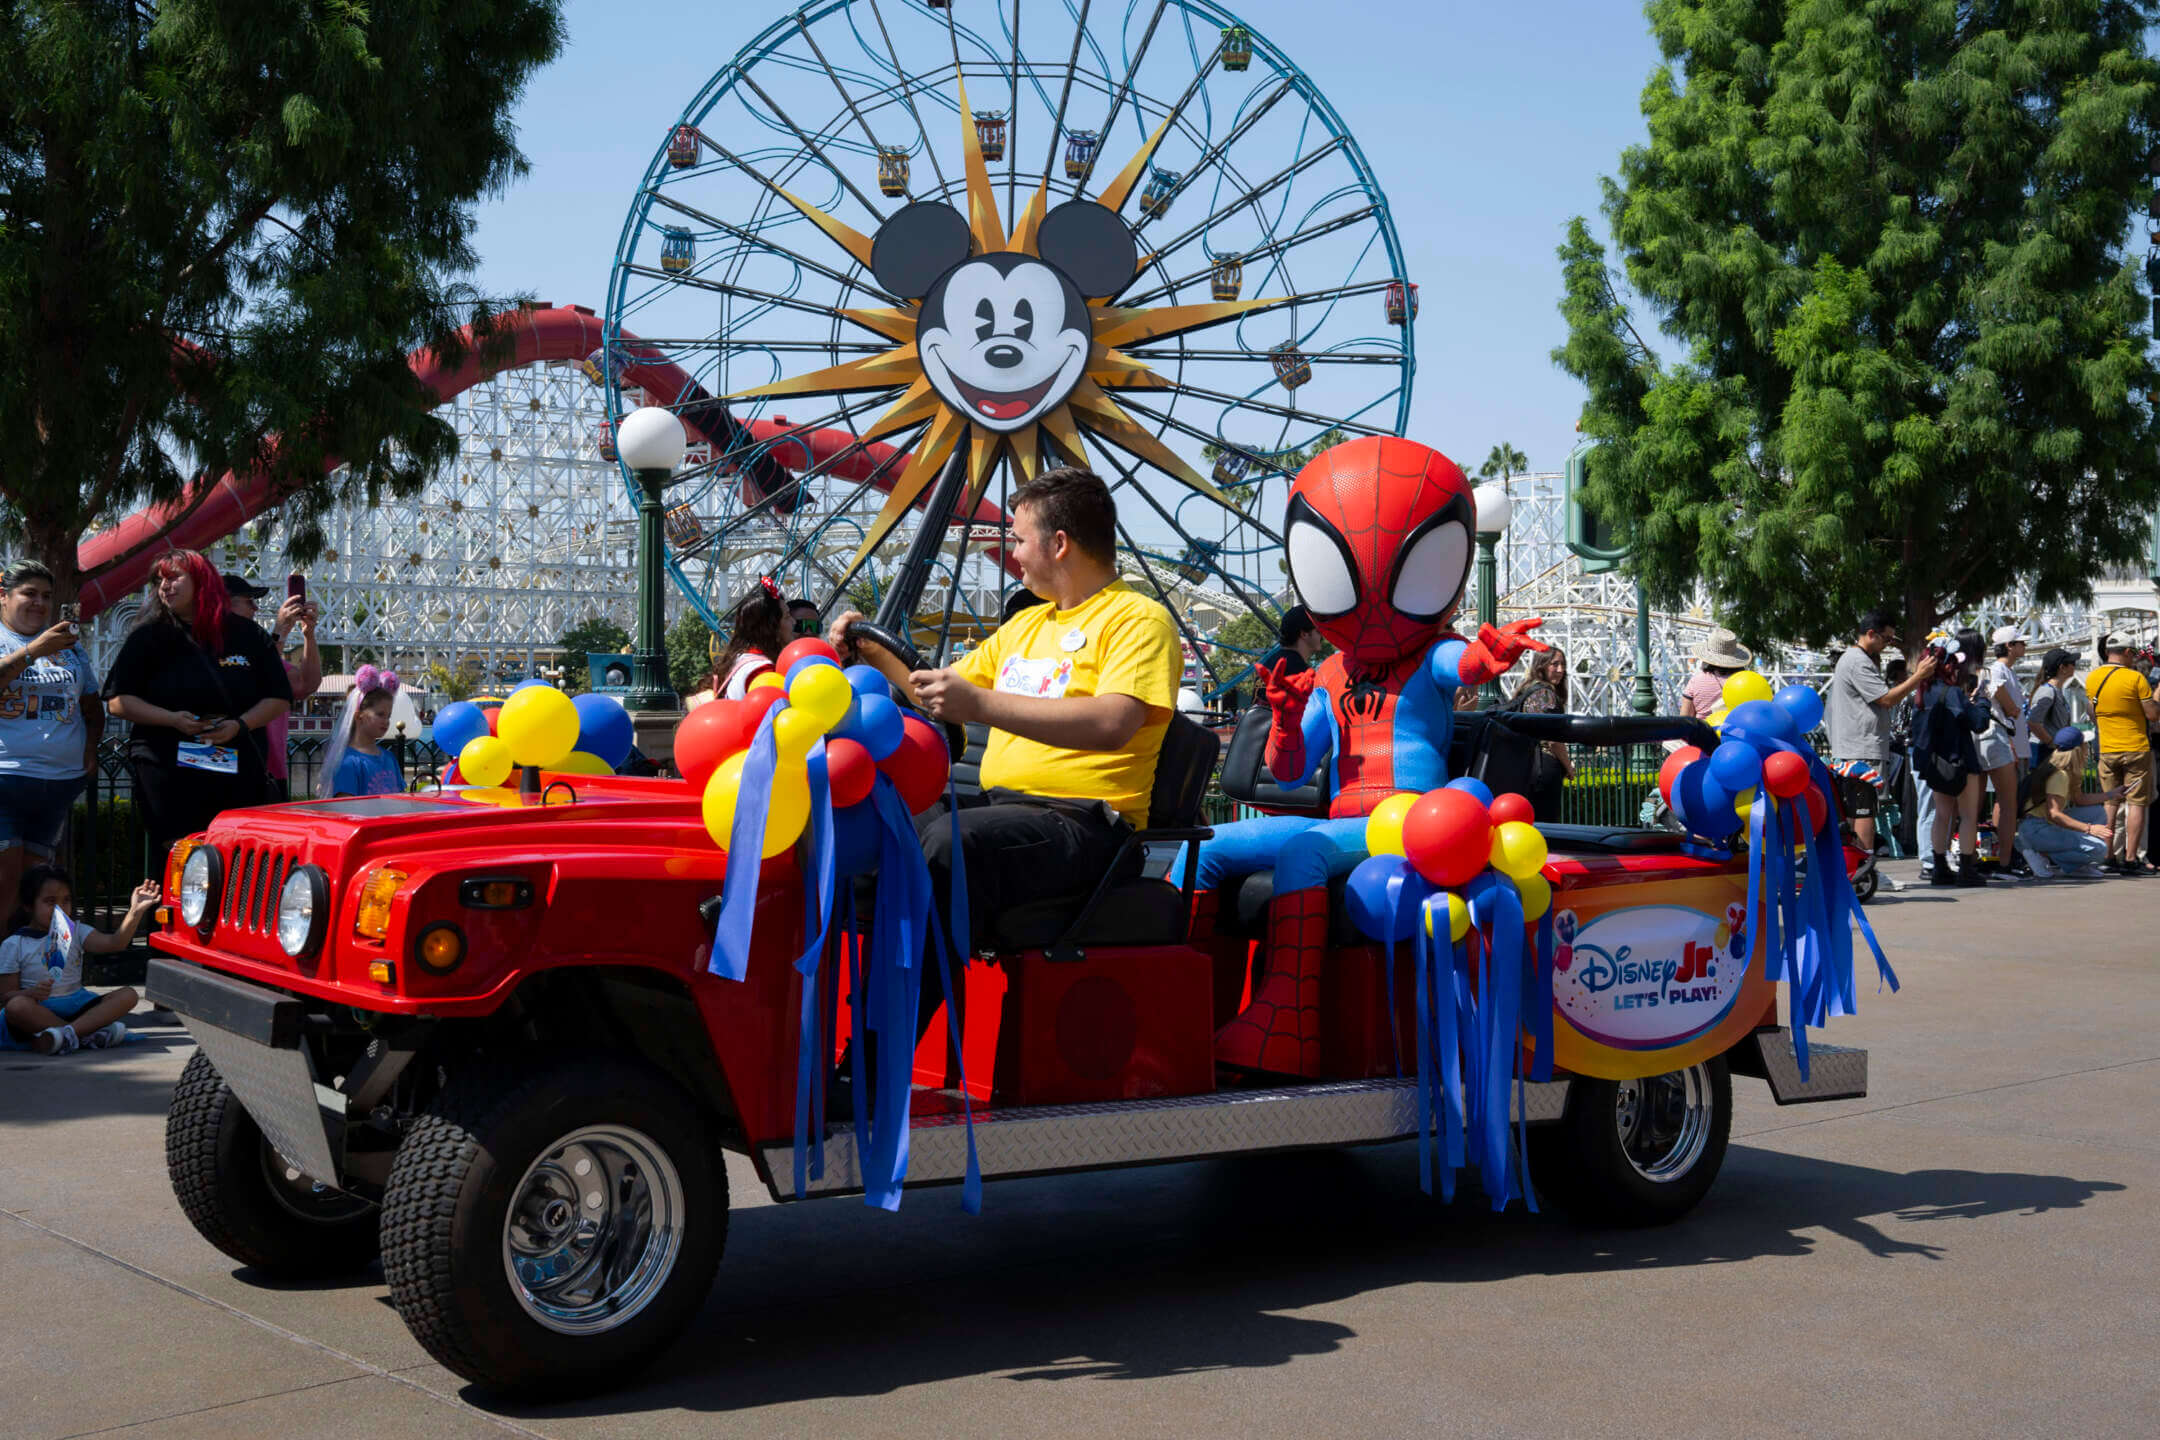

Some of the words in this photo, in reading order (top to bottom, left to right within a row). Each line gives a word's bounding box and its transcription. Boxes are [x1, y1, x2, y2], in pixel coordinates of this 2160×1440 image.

[1573, 944, 1677, 1000] Disney
[1674, 941, 1716, 983] Jr.
[1614, 991, 1659, 1011] LET'S
[1669, 986, 1718, 1005] PLAY!
